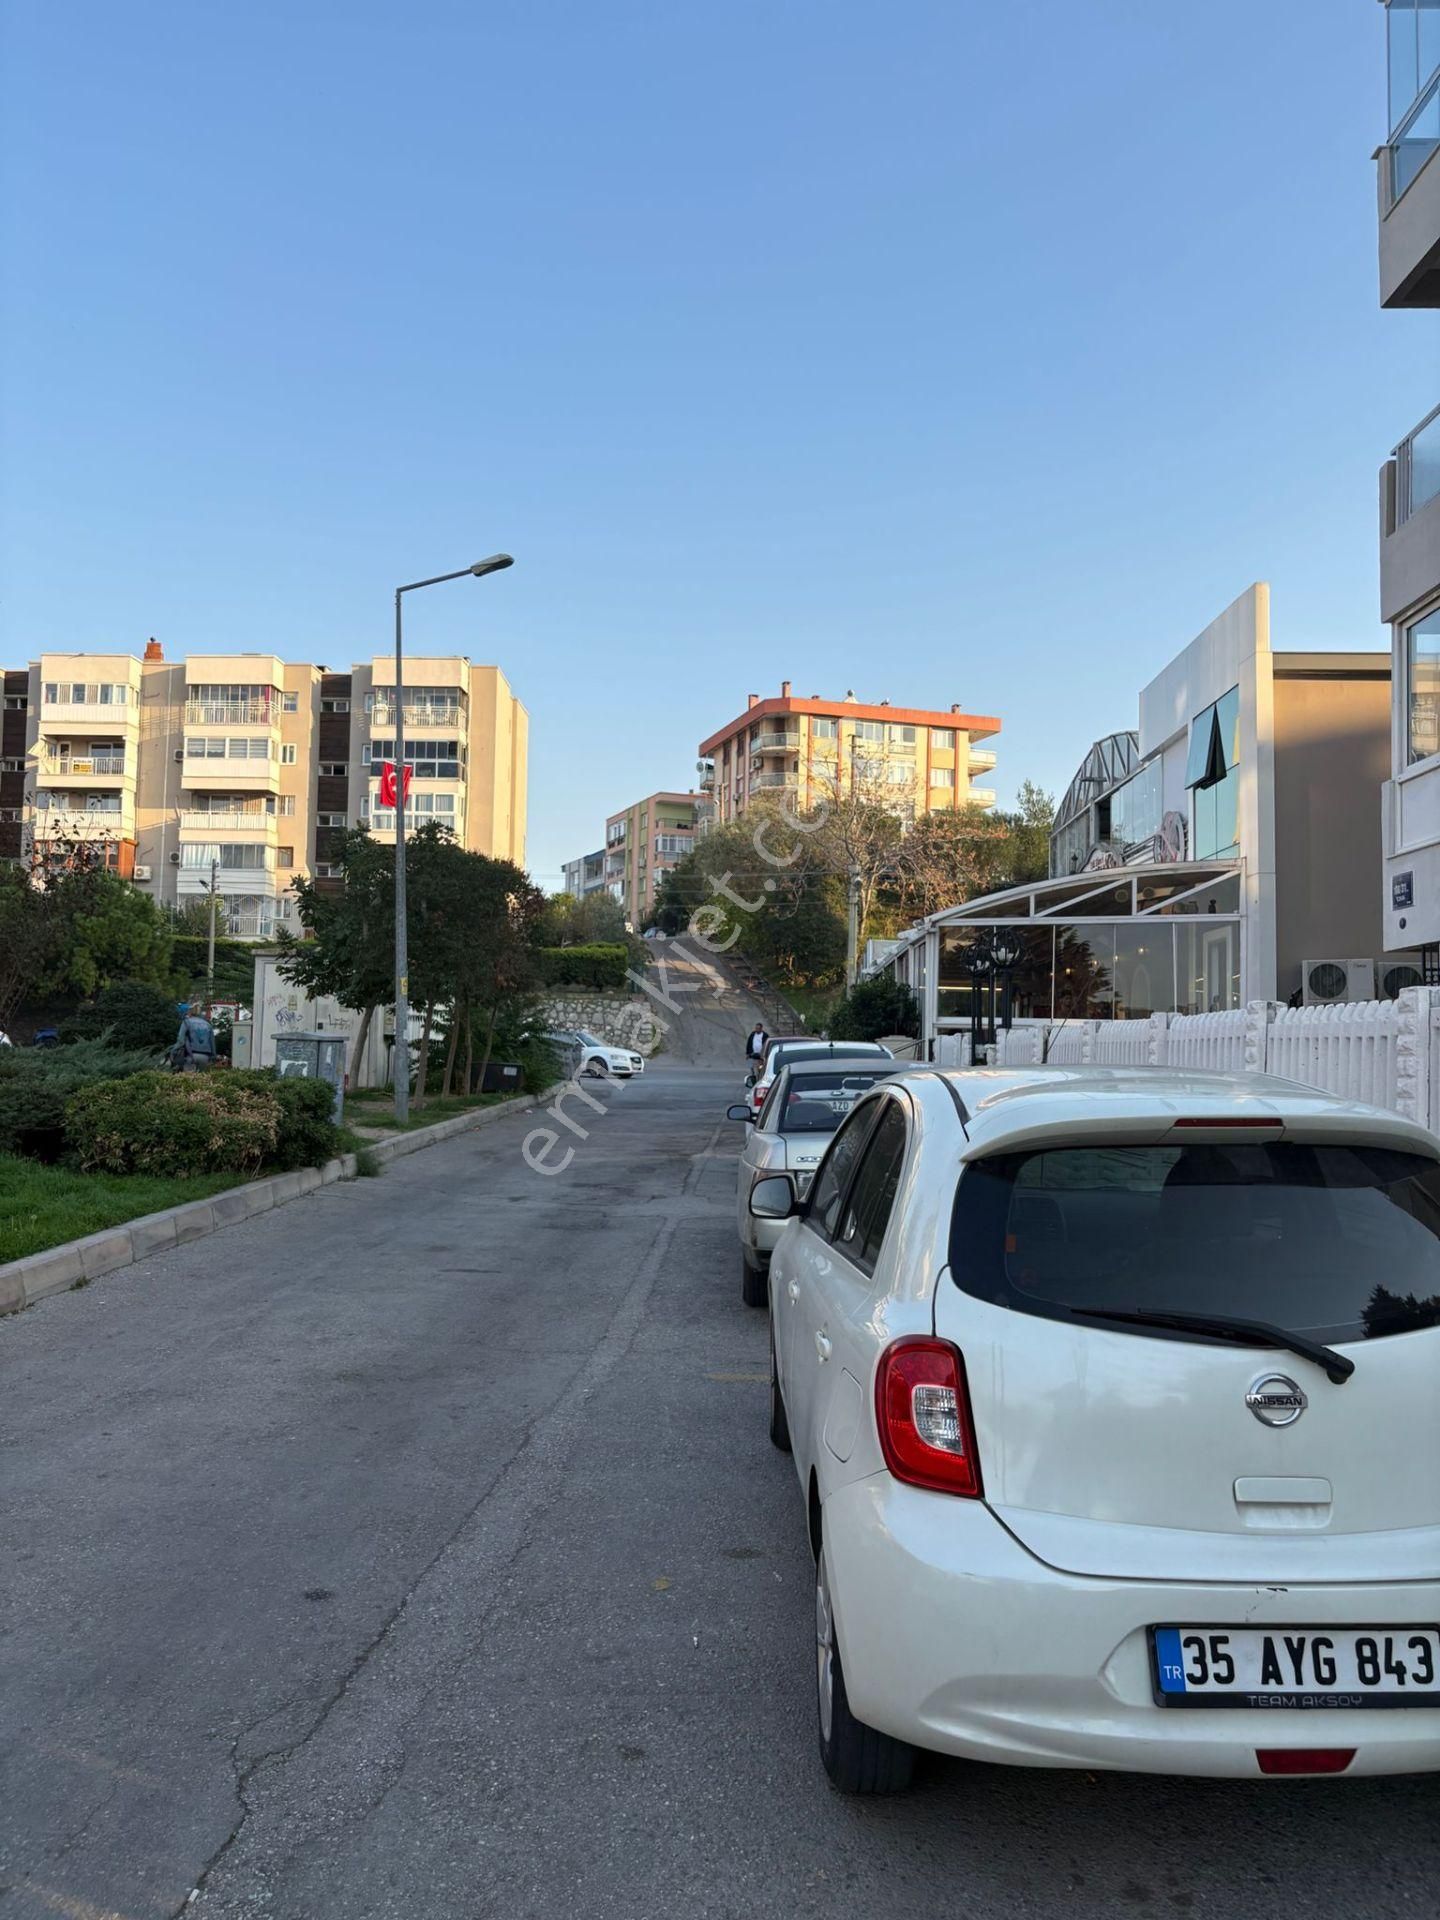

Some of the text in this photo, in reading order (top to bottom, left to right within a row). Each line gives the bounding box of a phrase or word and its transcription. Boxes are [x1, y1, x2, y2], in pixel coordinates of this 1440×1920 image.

[1253, 1396, 1303, 1406] NISSAN
[1183, 1636, 1434, 1686] 35 AYG 843
[1164, 1666, 1183, 1680] TR
[1247, 1695, 1363, 1708] TEAM AKSOY
